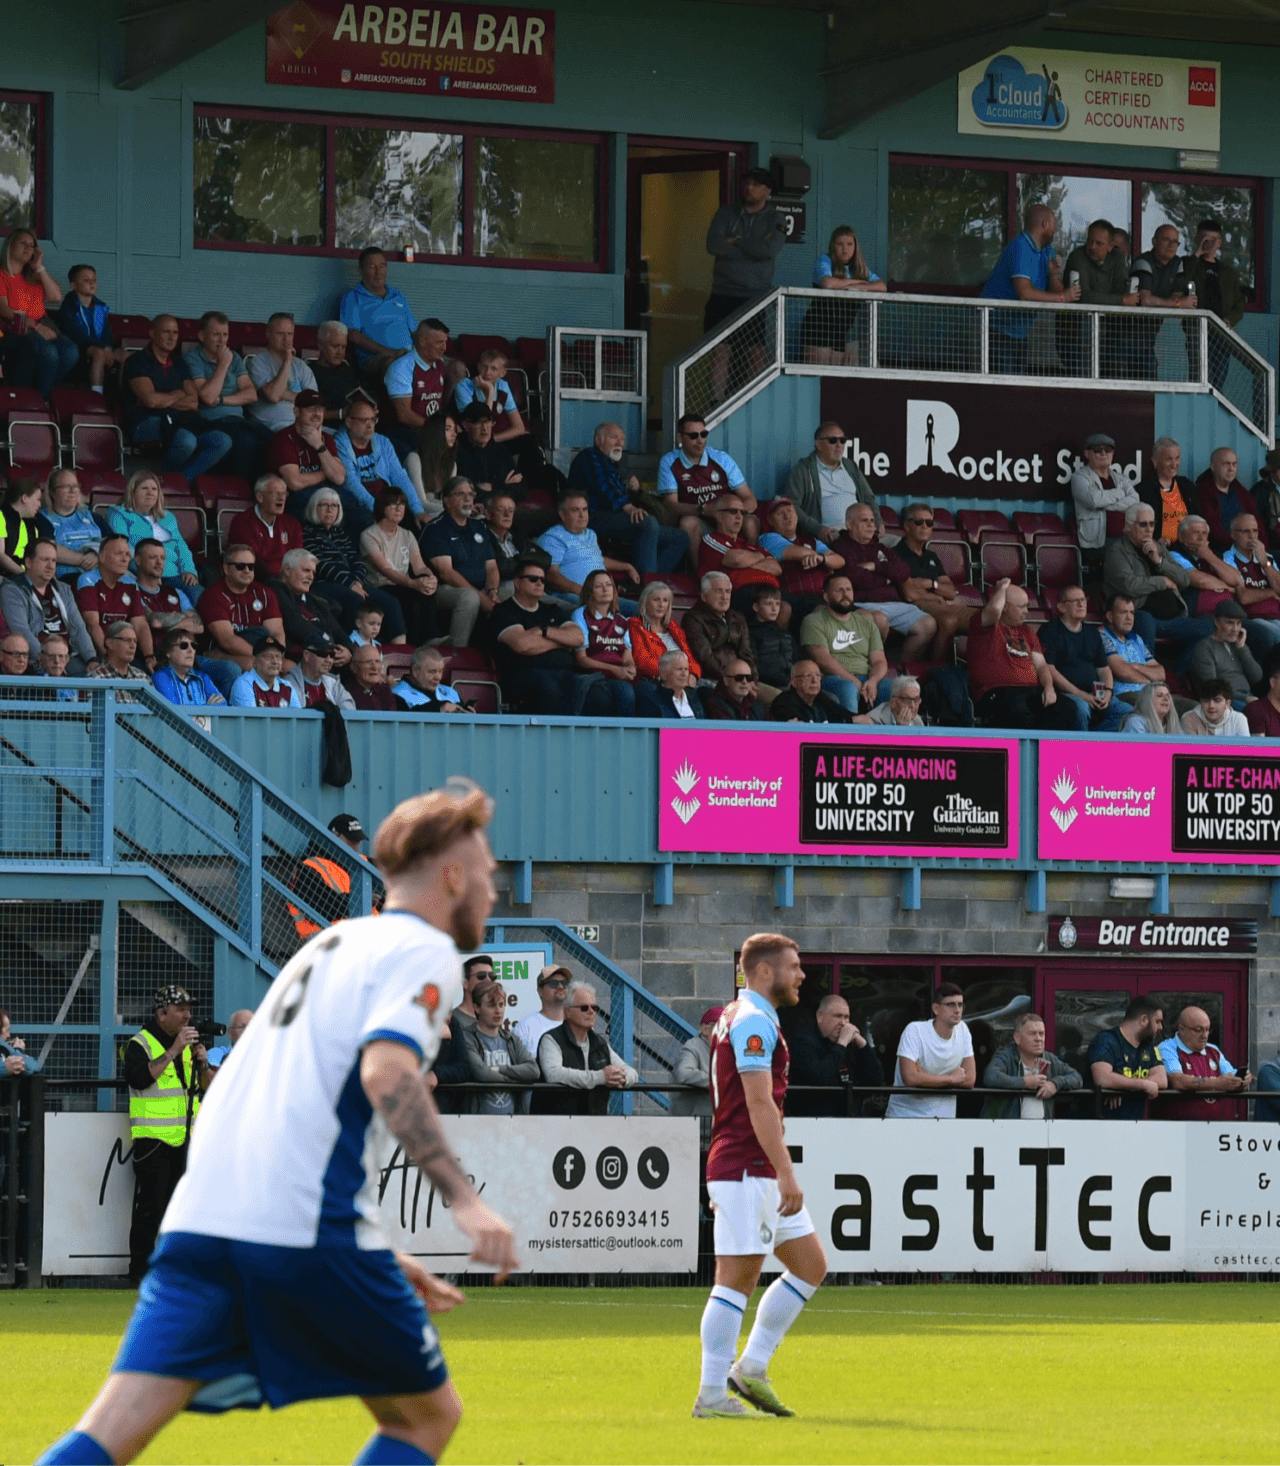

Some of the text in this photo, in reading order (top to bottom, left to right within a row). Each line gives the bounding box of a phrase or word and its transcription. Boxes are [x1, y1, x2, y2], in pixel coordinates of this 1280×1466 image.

[333, 3, 546, 55] ARBEIA BAR
[380, 50, 495, 75] SOUTH SHIELDS
[354, 73, 427, 86] ARBEIASOUTHSHIELDS
[453, 80, 537, 94] ARBEIABARSOUTHSHIELDS
[1085, 69, 1164, 88] CHARTERED
[1189, 81, 1215, 93] ACCA
[999, 84, 1042, 107] Cloud
[1085, 90, 1151, 108] CERTIFIED
[986, 106, 1042, 121] Accountants
[1085, 113, 1185, 131] ACCOUNTANTS
[906, 399, 1043, 484] Rocket
[687, 484, 722, 495] Pulman
[815, 756, 957, 781] A LIFE-CHANGING
[1186, 766, 1198, 788] A
[708, 776, 783, 795] University of
[815, 782, 906, 806] UK TOP 50
[708, 793, 778, 808] Sunderland
[945, 793, 973, 811] The
[1085, 786, 1156, 805] University of
[1187, 792, 1273, 816] UK TOP 50
[933, 805, 1000, 824] Guardian
[1085, 803, 1151, 818] Sunderland
[815, 809, 915, 833] UNIVERSITY
[933, 825, 1000, 836] University Guide 2023
[1098, 920, 1230, 946] Bar Entrance
[1258, 1172, 1271, 1190] &
[786, 1145, 1172, 1252] astTec
[549, 1210, 670, 1228] 07526693415
[528, 1236, 684, 1251] mysistersattic@outlook.com
